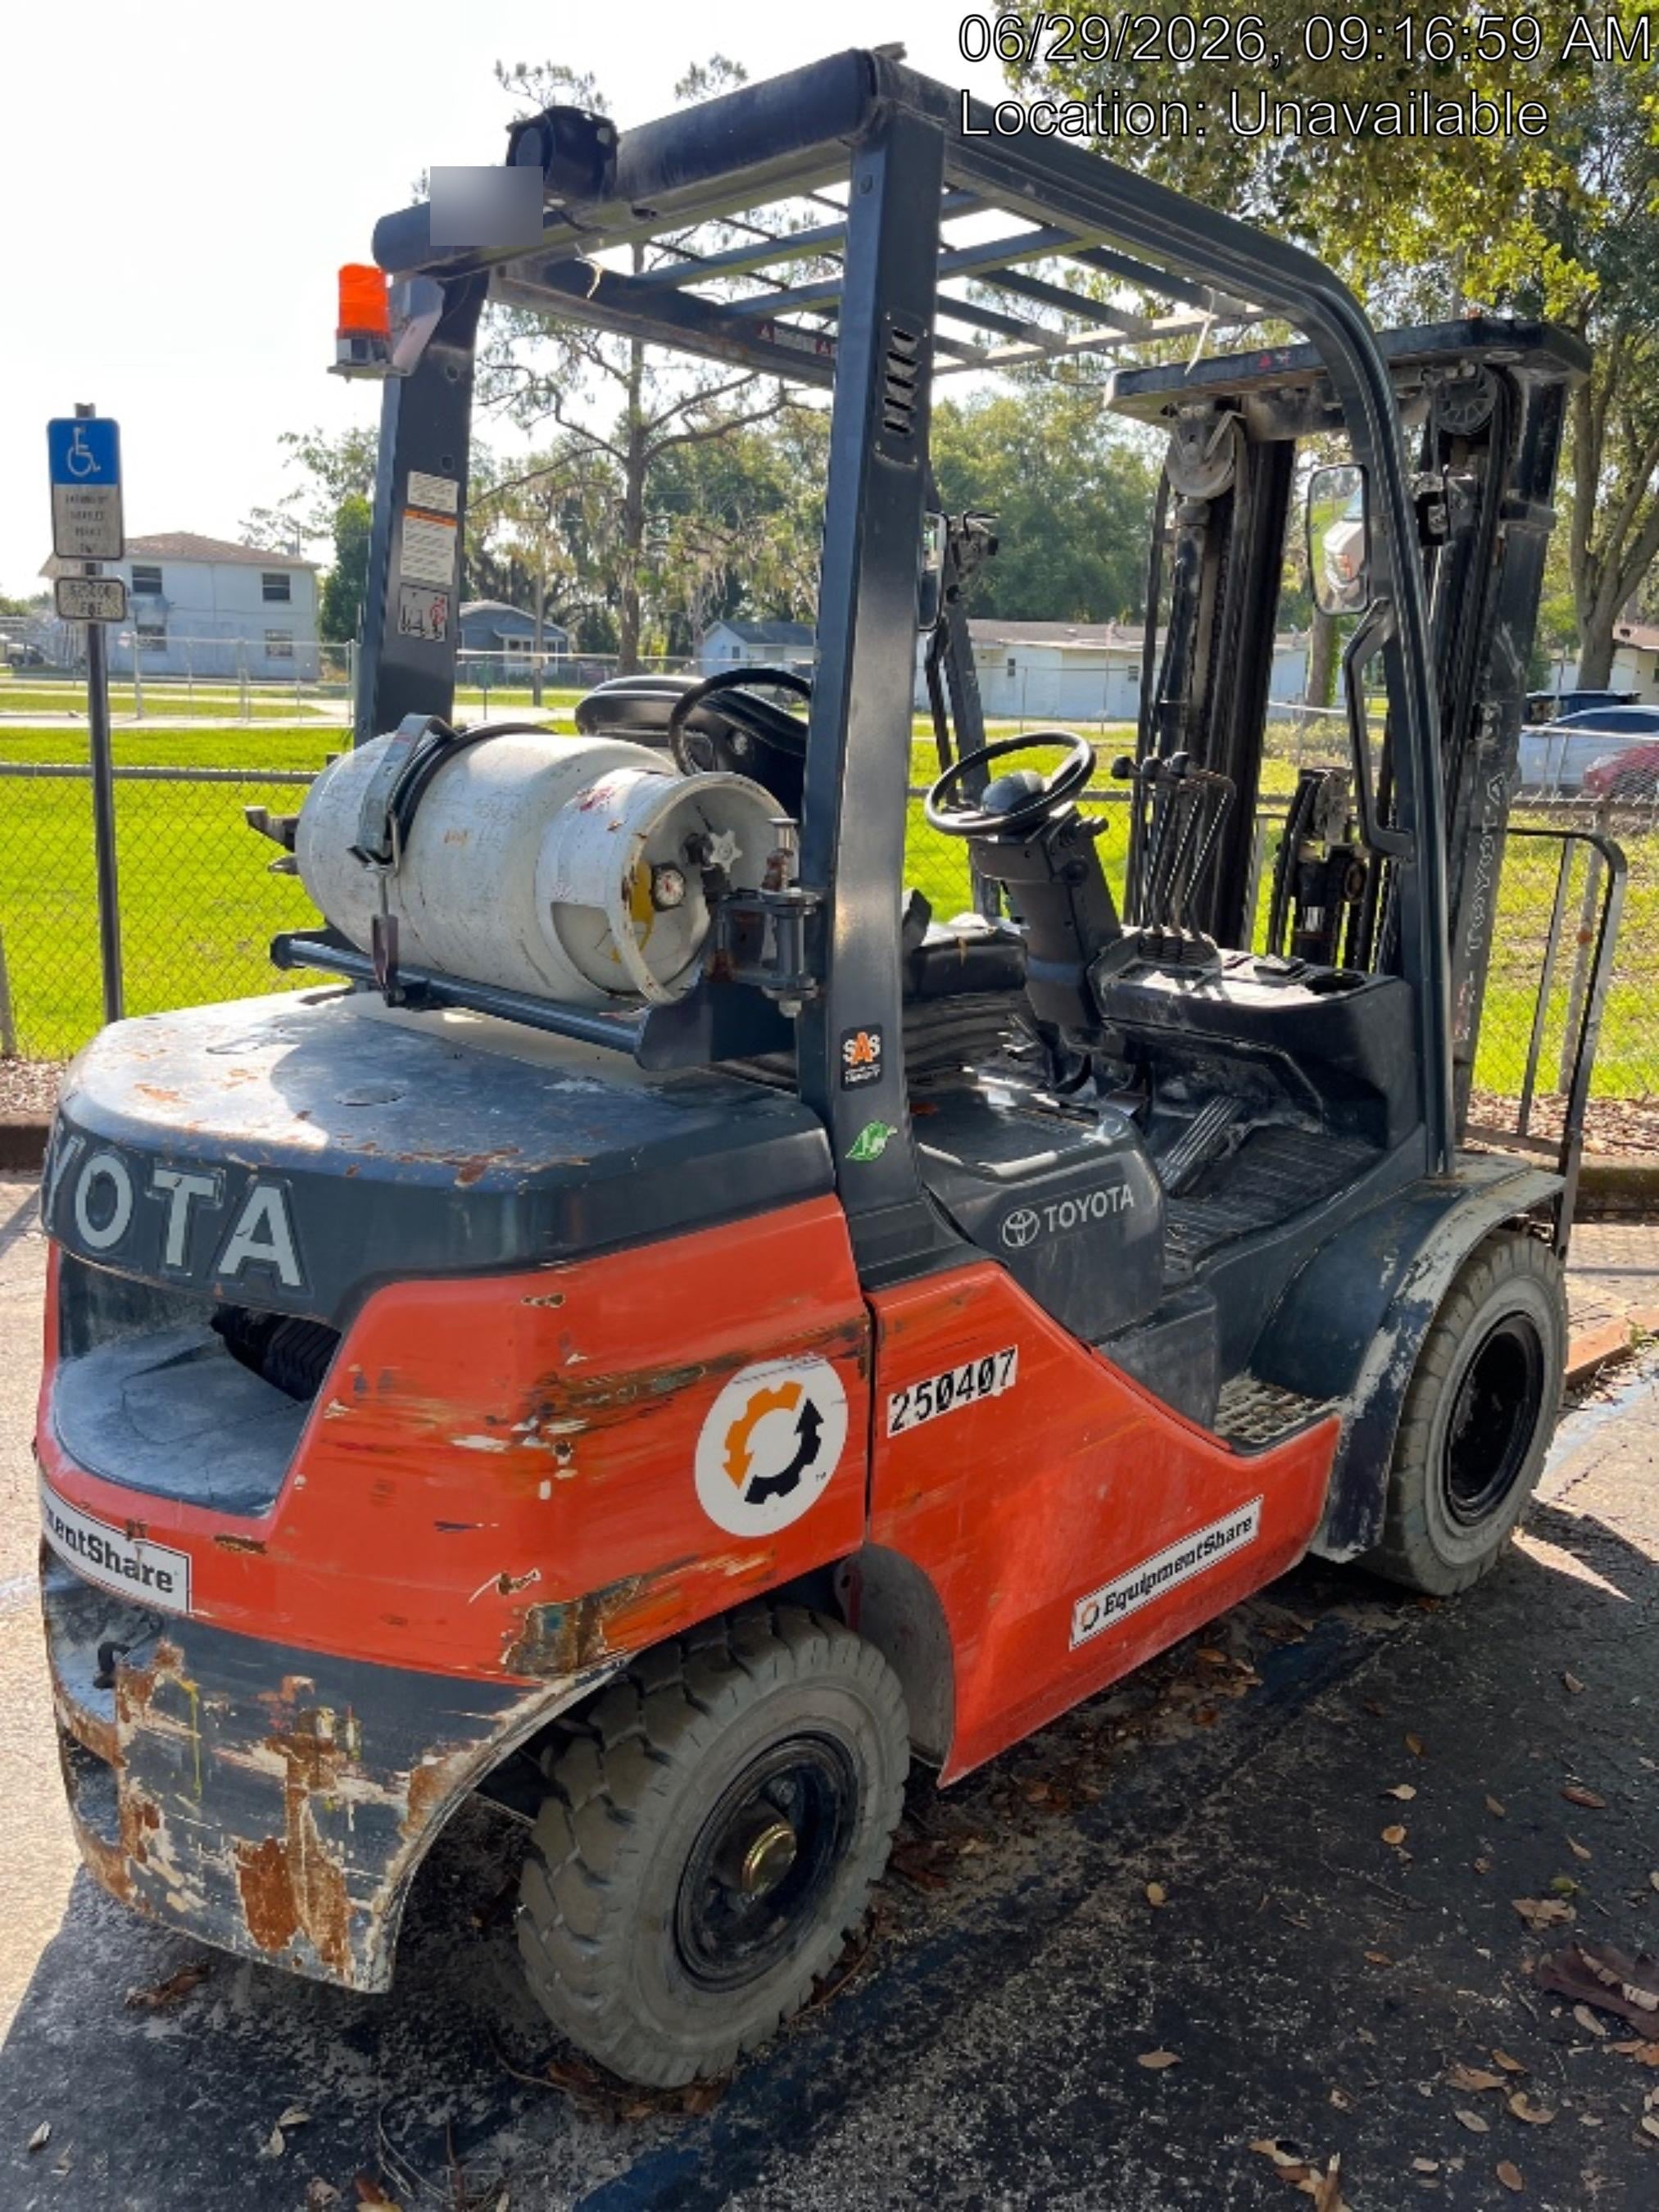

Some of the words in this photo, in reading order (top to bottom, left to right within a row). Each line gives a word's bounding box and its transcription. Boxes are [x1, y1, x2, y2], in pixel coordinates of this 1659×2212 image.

[1044, 1185, 1135, 1232] TOYOTA
[891, 1348, 1016, 1433] 250407
[47, 1508, 174, 1593] entShare
[1103, 1516, 1253, 1617] EquipmentShare
